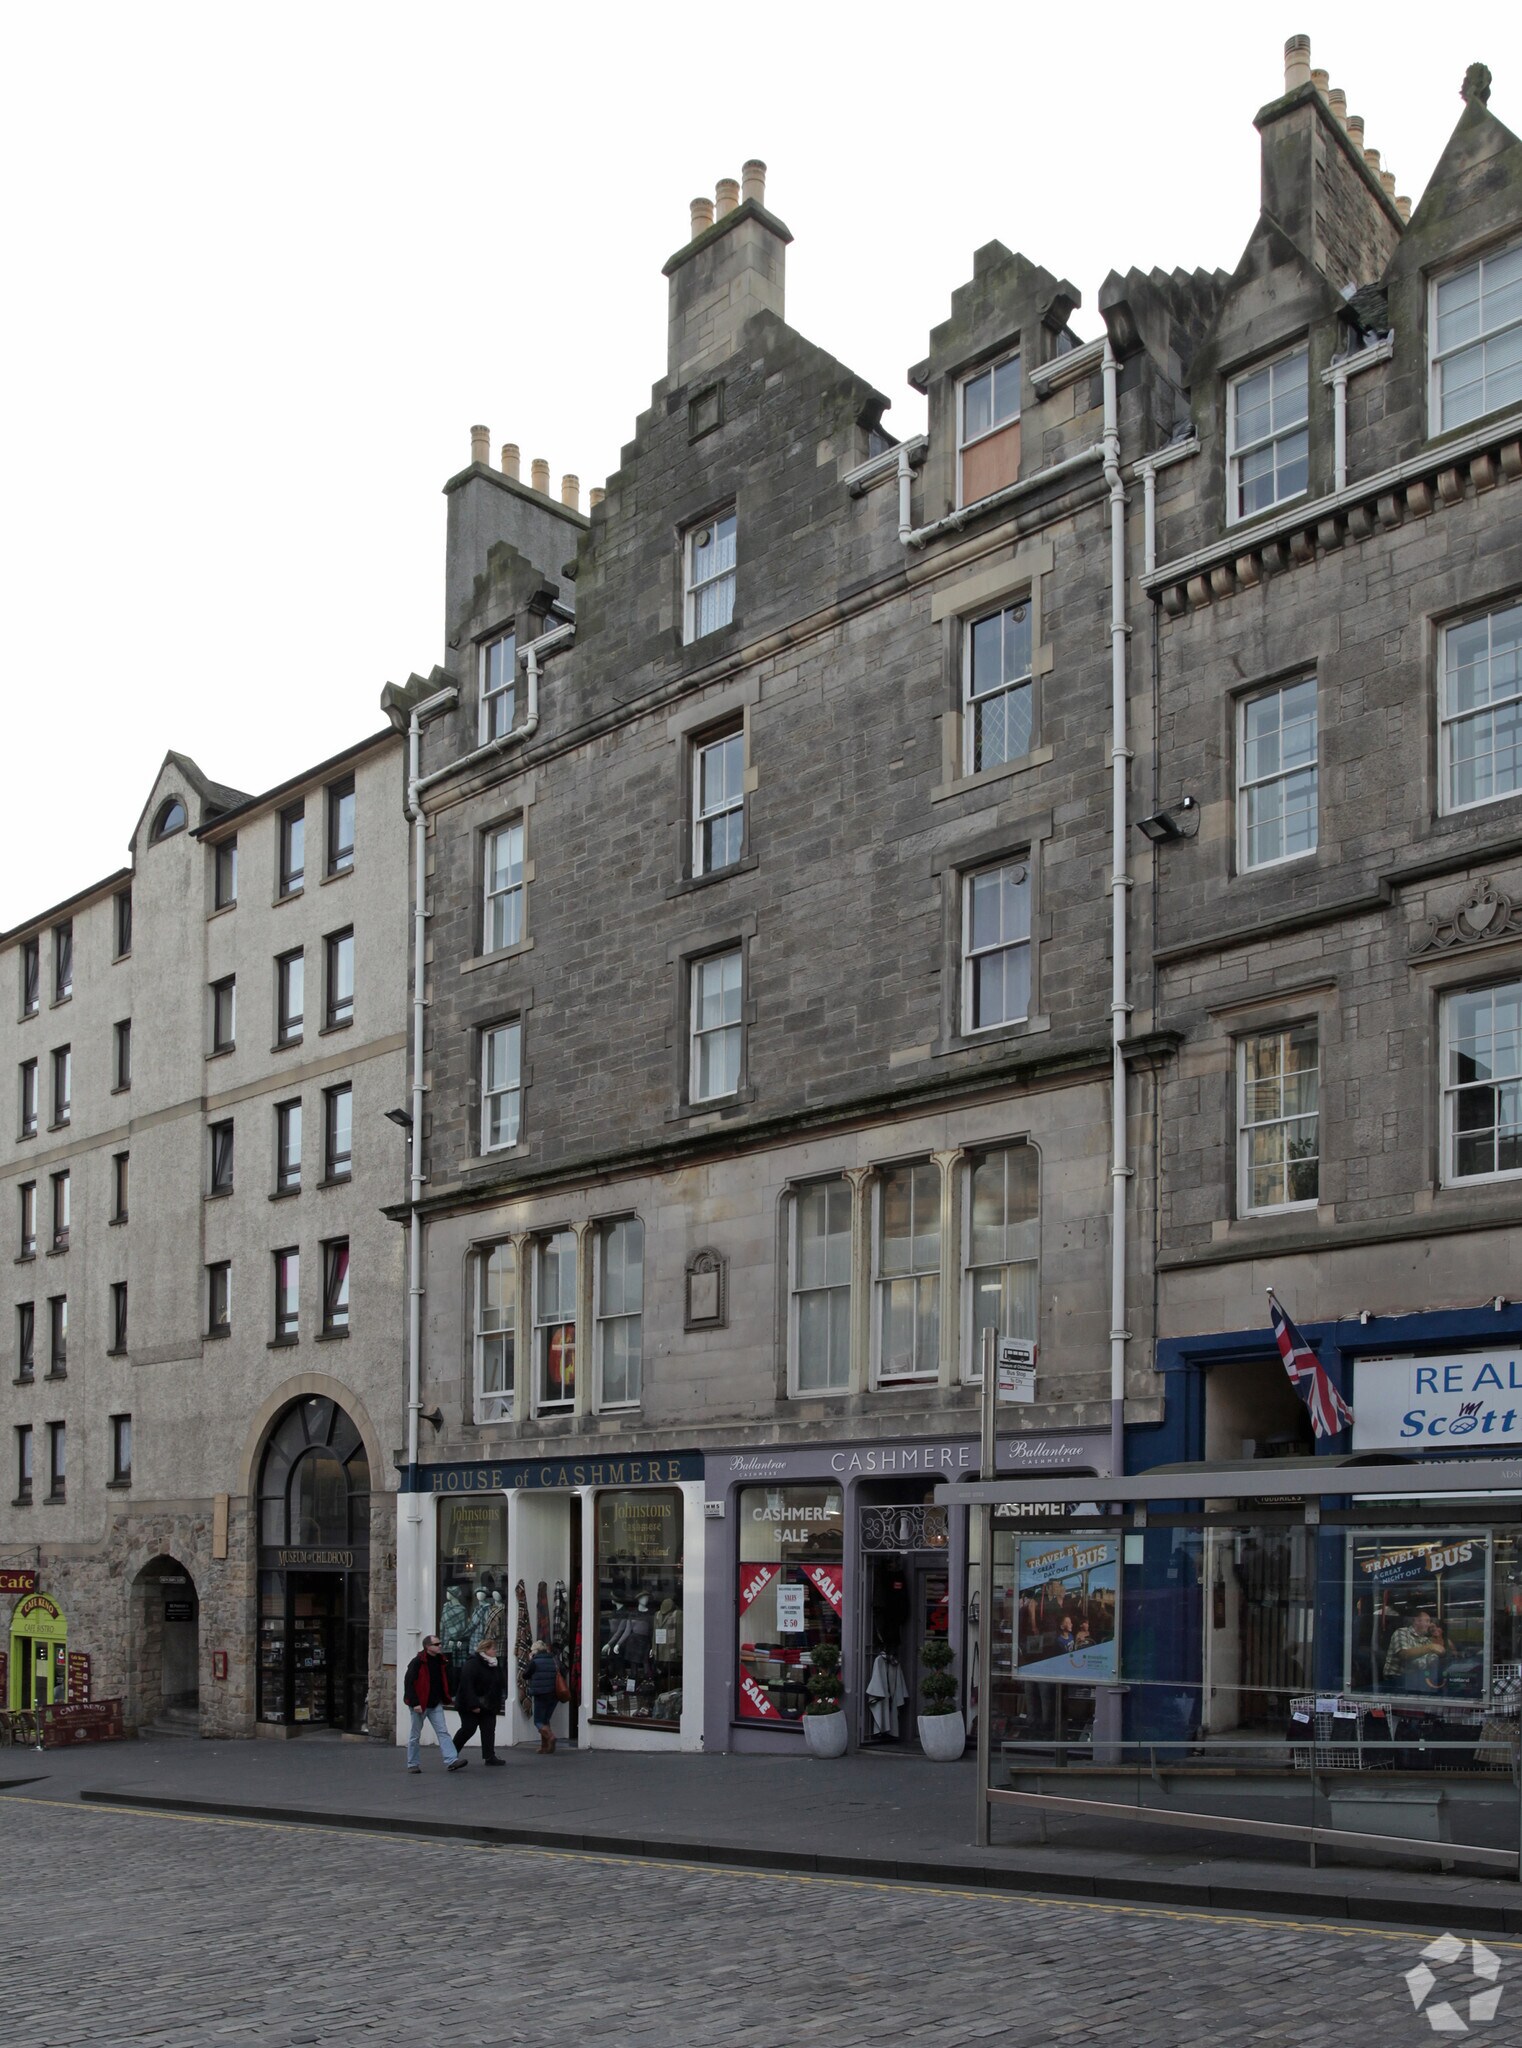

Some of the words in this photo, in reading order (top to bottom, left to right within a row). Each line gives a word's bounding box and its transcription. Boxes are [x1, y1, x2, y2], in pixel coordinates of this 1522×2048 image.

[1416, 1362, 1522, 1394] REAL
[1009, 1440, 1085, 1458] Ballantrae
[729, 1455, 788, 1471] Ballantrae
[831, 1447, 970, 1472] CASHMERE
[432, 1470, 503, 1491] HOUSE
[515, 1469, 529, 1488] of
[541, 1460, 681, 1487] CASHMERE
[452, 1506, 500, 1523] Johnstons
[614, 1502, 671, 1522] Johnstons
[752, 1507, 832, 1521] CASHMERE
[773, 1529, 809, 1543] SALE
[278, 1551, 307, 1566] MUSEUM
[312, 1551, 353, 1568] CHILDHOOD
[1028, 1551, 1066, 1568] TRAVEL
[1067, 1545, 1080, 1558] BY
[1076, 1546, 1108, 1569] BUS
[1365, 1551, 1414, 1574] TRAVEL
[1416, 1546, 1433, 1558] BY
[1430, 1544, 1472, 1572] BUS
[1037, 1563, 1056, 1573] GREAT
[1056, 1566, 1069, 1575] OUT
[1380, 1566, 1402, 1577] GREAT
[1382, 1572, 1405, 1584] NIGHT
[1405, 1567, 1421, 1577] OUT
[0, 1575, 34, 1589] Cafe
[743, 1567, 772, 1604] SALE
[811, 1567, 843, 1606] SALE
[24, 1598, 37, 1612] CAFE
[24, 1624, 36, 1632] CAFE
[37, 1625, 55, 1633] BISTRO
[741, 1677, 771, 1715] SALE
[60, 1703, 80, 1715] CAFE
